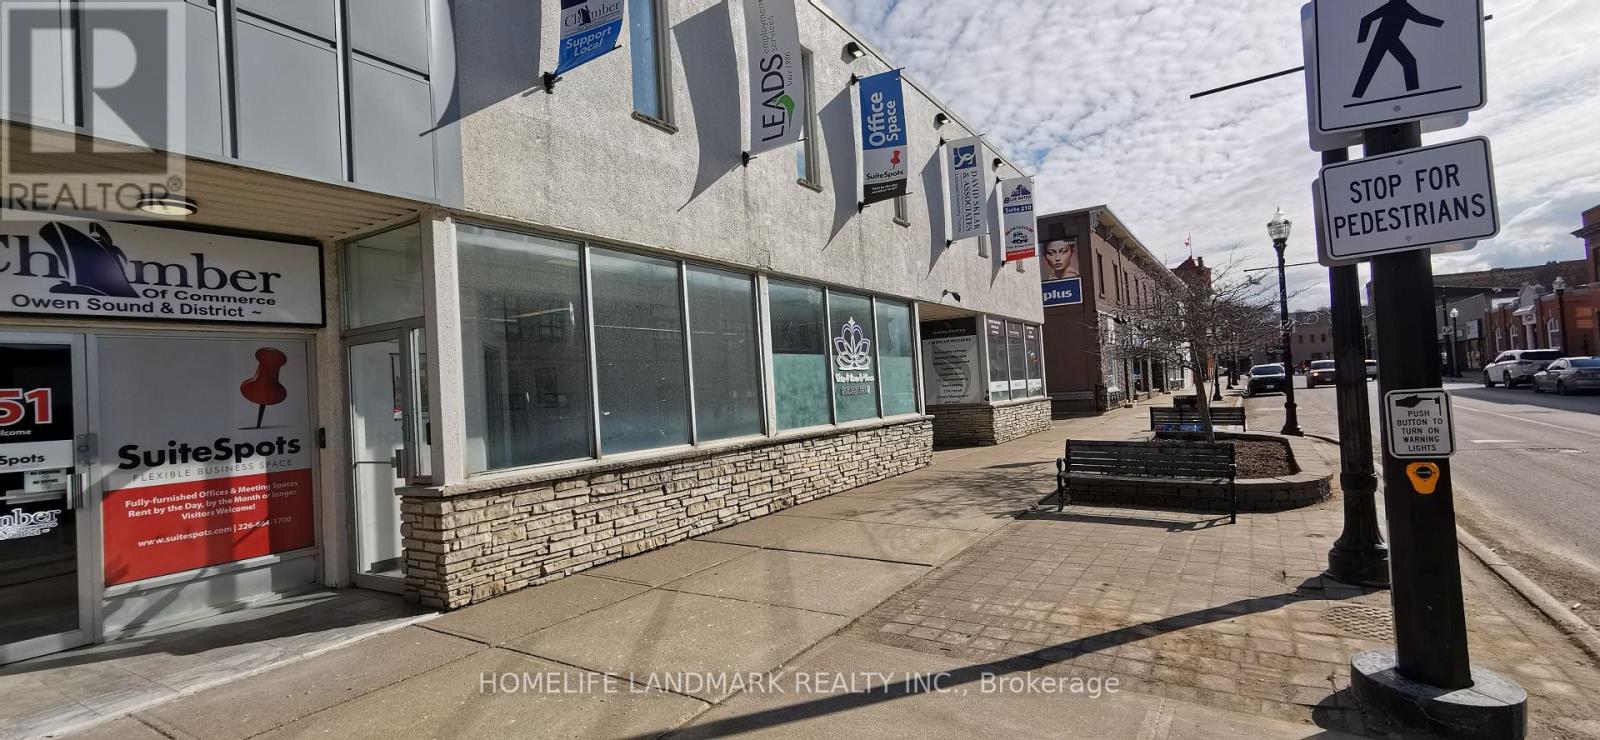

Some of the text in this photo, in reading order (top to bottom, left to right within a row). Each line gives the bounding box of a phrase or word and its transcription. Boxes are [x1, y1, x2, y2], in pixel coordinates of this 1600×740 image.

[566, 26, 612, 49] Support
[769, 15, 778, 52] services
[574, 39, 603, 57] Local
[784, 52, 794, 88] Since 1986
[759, 53, 786, 142] LEADS
[868, 91, 886, 146] Office
[886, 100, 901, 141] Space
[866, 170, 904, 180] SuiteSpots
[1349, 163, 1460, 204] STOP FOR
[962, 181, 973, 232] ASSOCIATES
[970, 170, 981, 230] DAVID SKLAR
[1333, 193, 1486, 239] PEDESTRIANS
[11, 294, 80, 310] Owen
[87, 297, 154, 314] Sound
[160, 302, 174, 315] &
[180, 303, 244, 317] District
[142, 287, 276, 306] Of Commerce
[1043, 289, 1073, 302] plus
[1396, 419, 1428, 427] BUTTON
[1401, 427, 1423, 435] TURN
[0, 453, 46, 467] Spots
[118, 435, 301, 470] SuiteSpots
[133, 458, 293, 483] FLEXIBLE BUSINESS SPACE
[125, 480, 299, 508] Fully-furnished Offices & Meeting Spaces
[128, 508, 152, 518] Rent
[153, 506, 165, 517] by
[167, 504, 183, 513] the
[184, 502, 205, 512] Day,
[206, 499, 217, 508] by
[218, 497, 233, 506] the
[233, 494, 261, 503] Month
[272, 489, 297, 500] longer
[181, 503, 257, 520] Visitors Welcome!
[137, 526, 232, 548] www.suitespots.com
